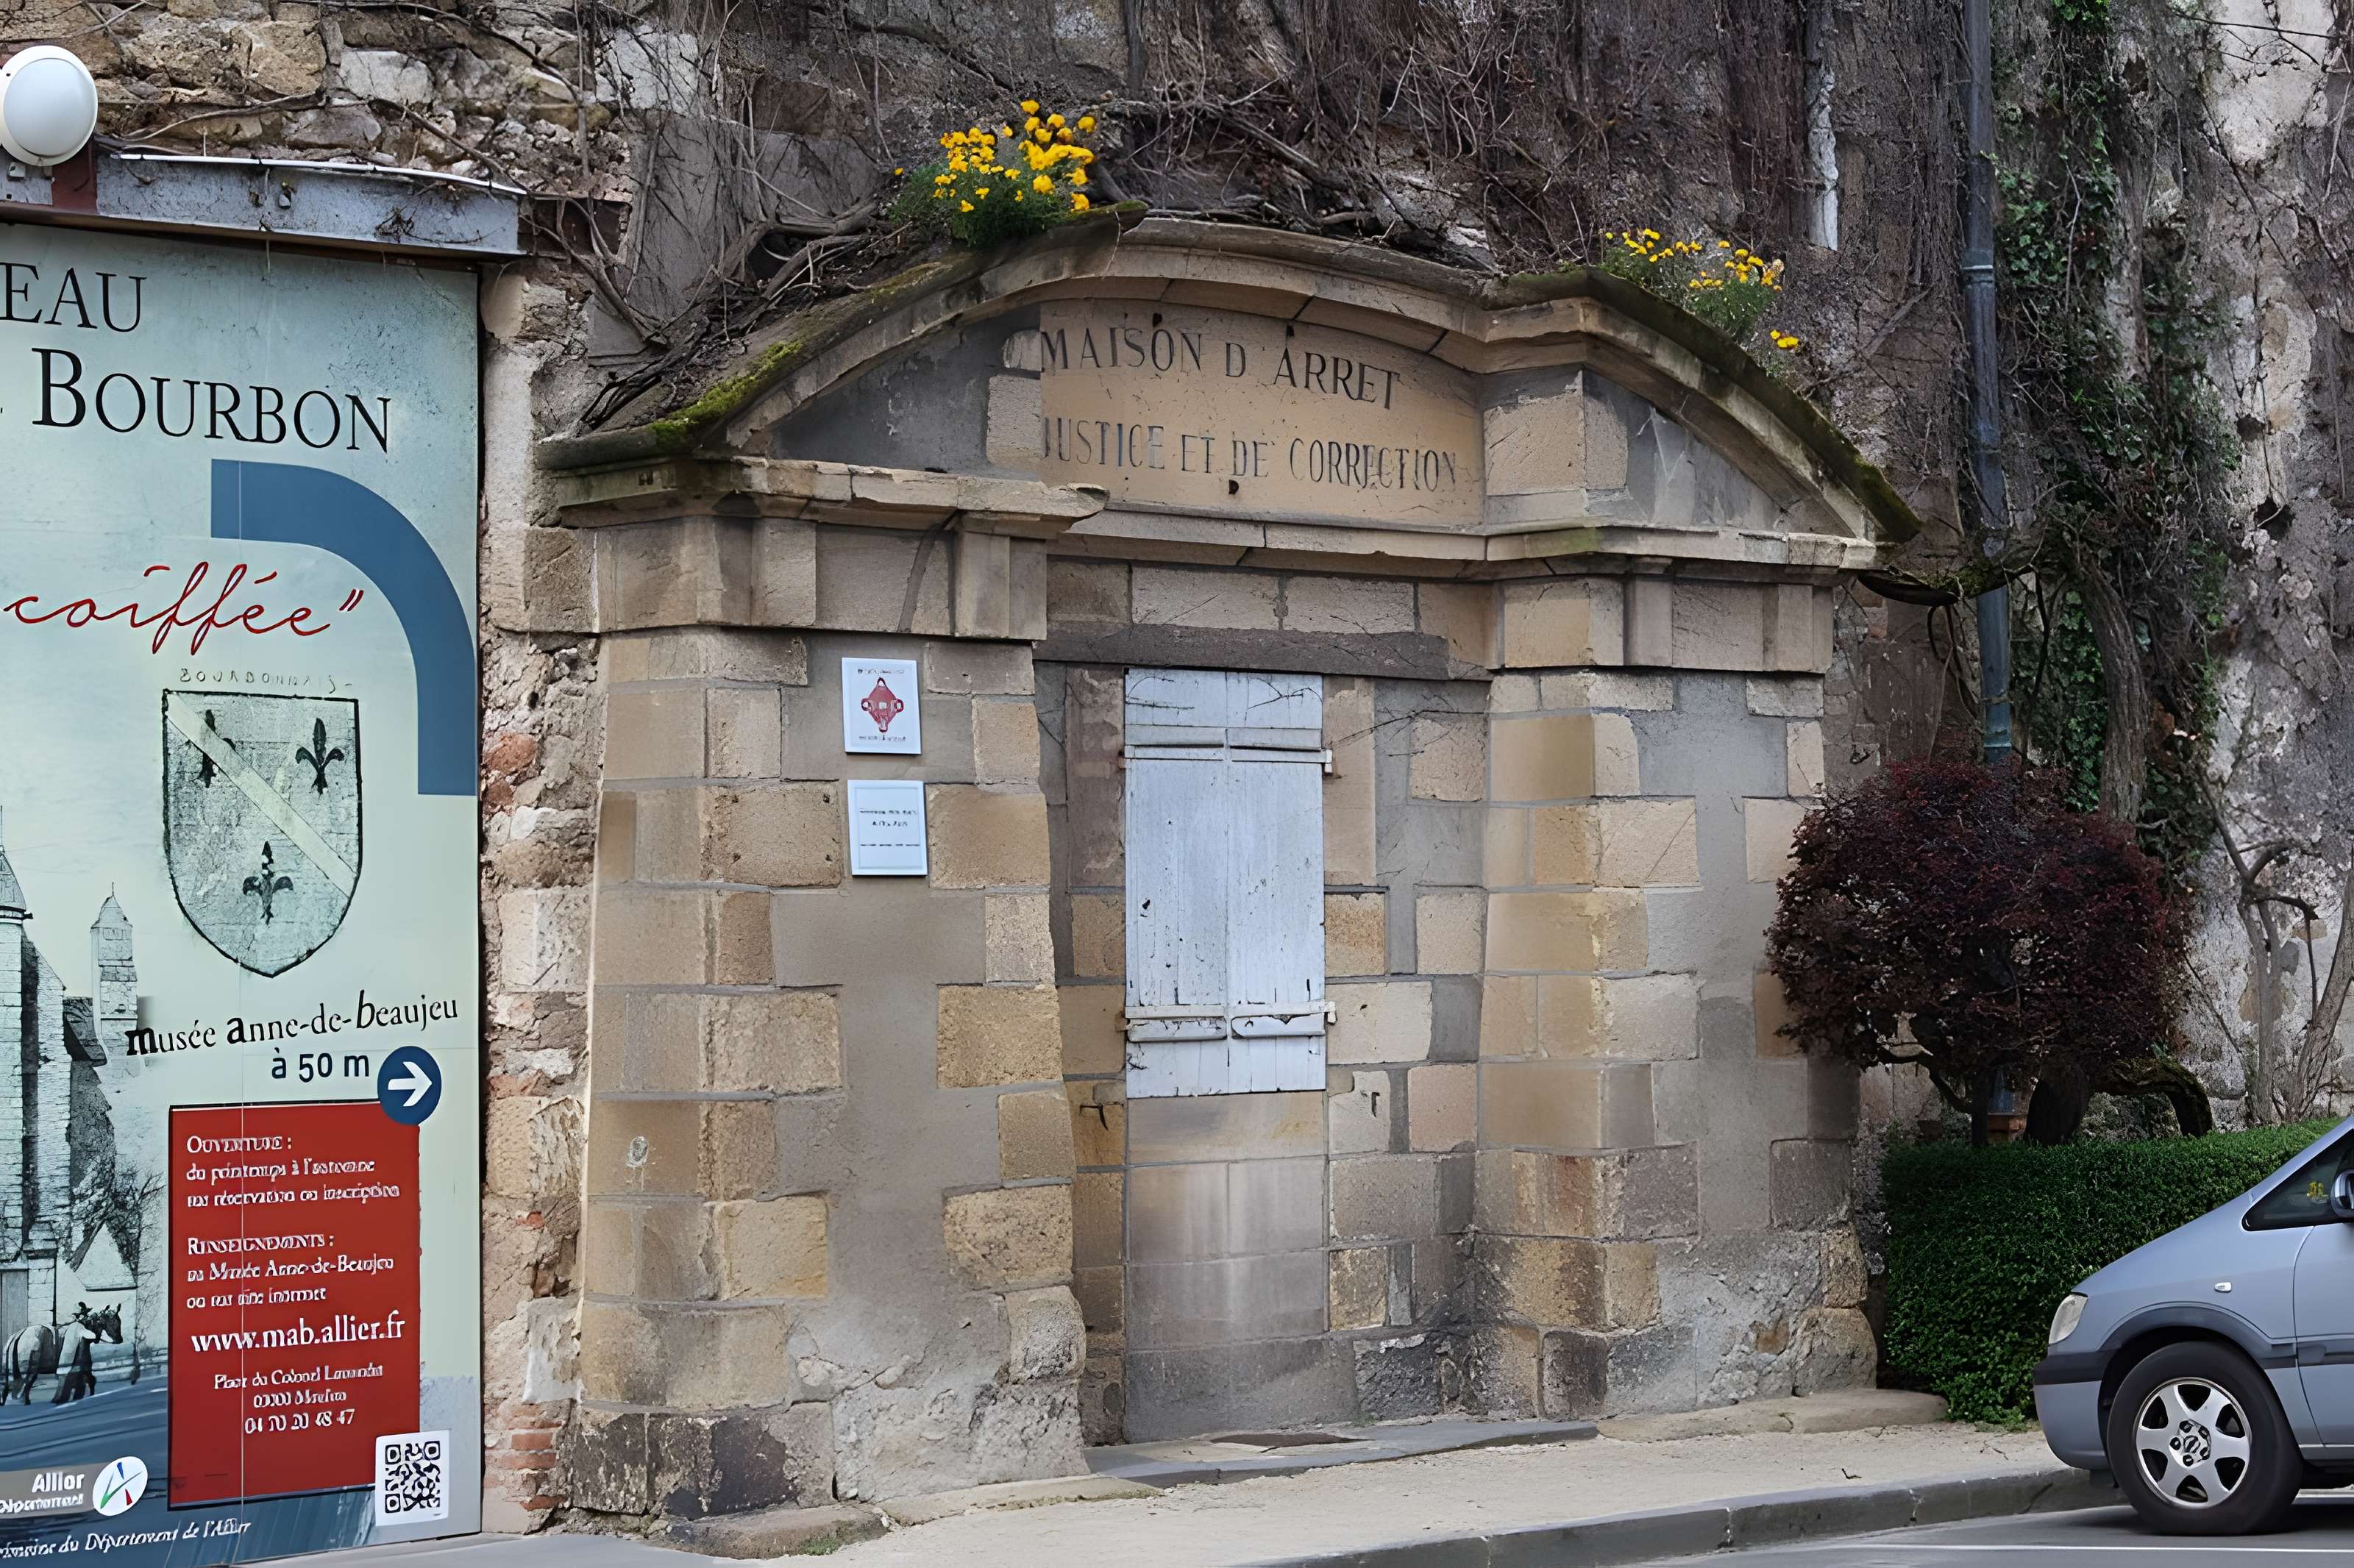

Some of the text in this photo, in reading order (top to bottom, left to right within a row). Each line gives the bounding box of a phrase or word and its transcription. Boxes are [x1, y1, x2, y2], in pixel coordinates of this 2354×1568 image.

[1040, 326, 1202, 374] MAISON
[1274, 346, 1401, 410] ARRET
[1040, 417, 1458, 492] JUSTICE ET DE CORRECTION
[126, 989, 458, 1056] musée anne-de-beaujeu
[271, 1047, 369, 1083] à 50 m
[190, 1309, 406, 1352] www.mab.allier.fr
